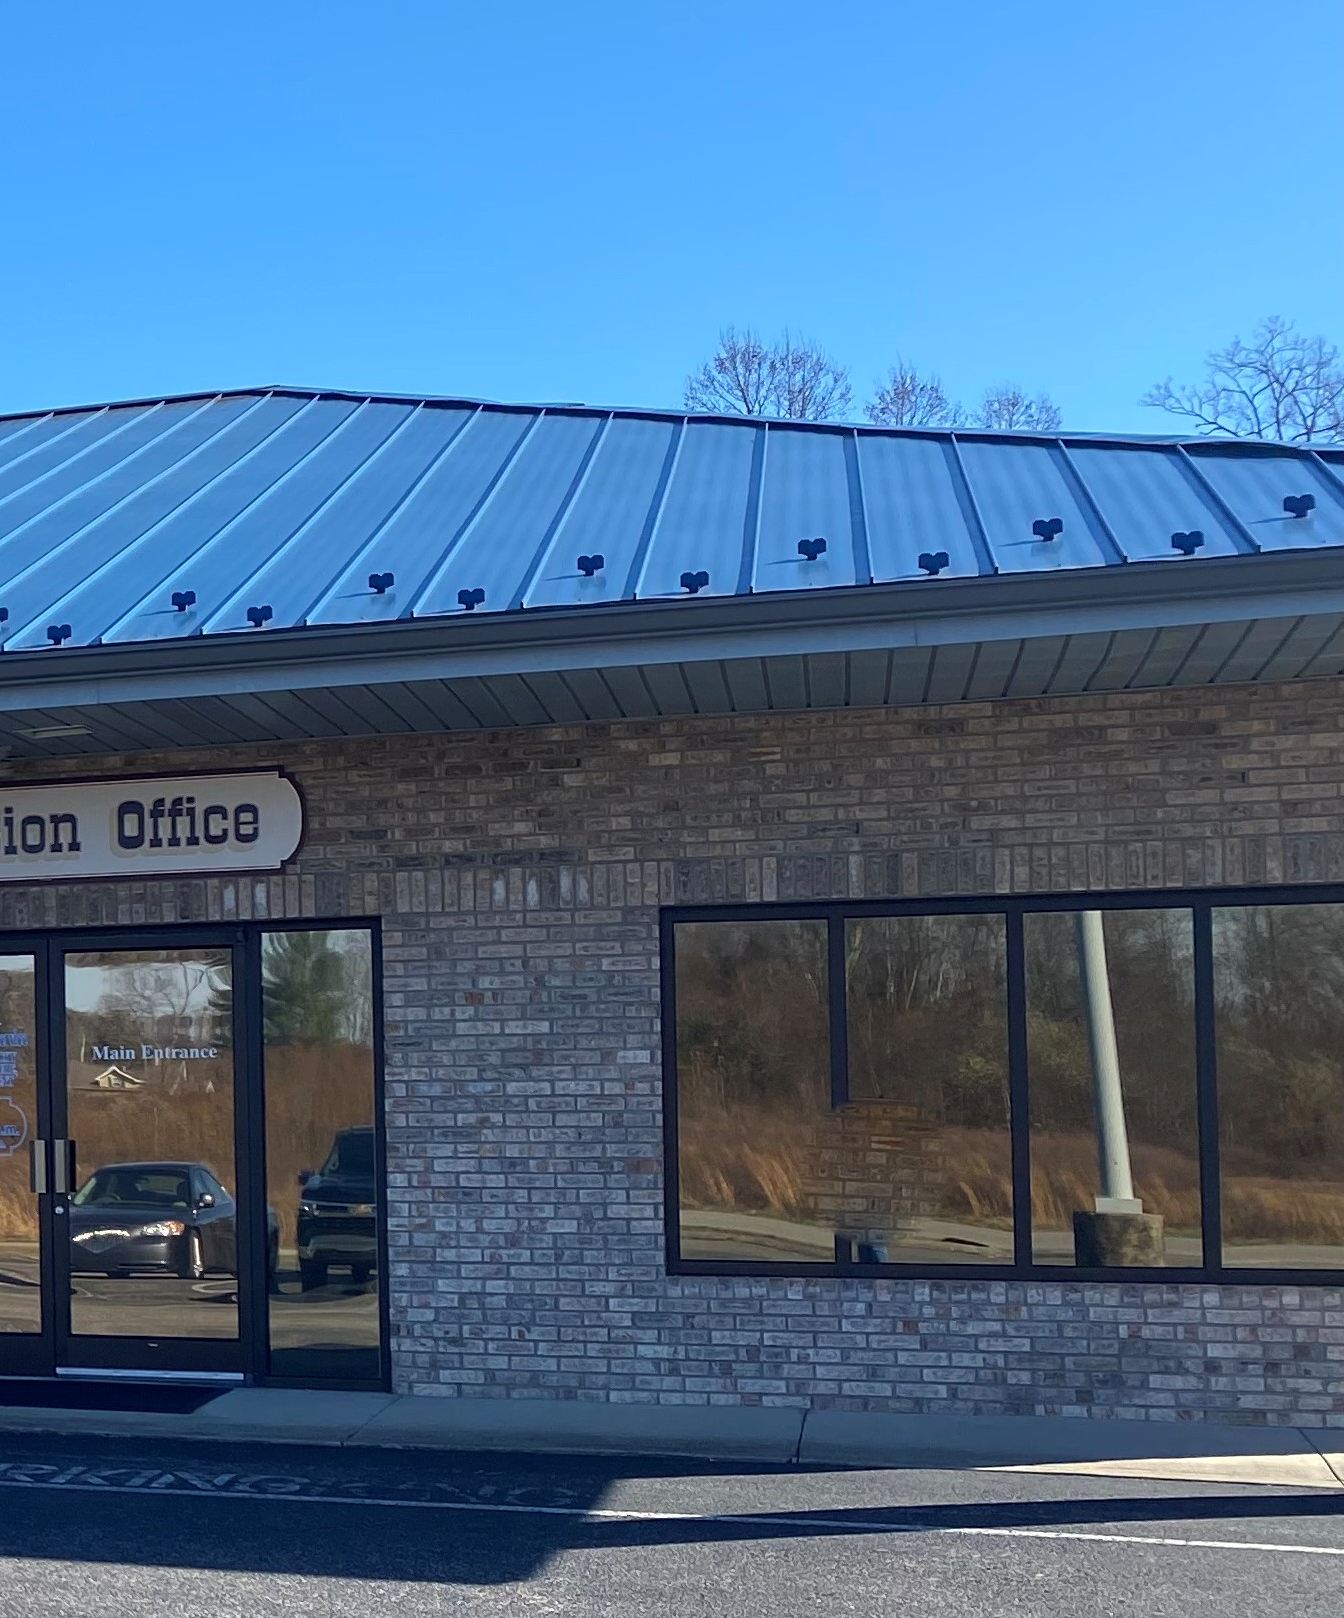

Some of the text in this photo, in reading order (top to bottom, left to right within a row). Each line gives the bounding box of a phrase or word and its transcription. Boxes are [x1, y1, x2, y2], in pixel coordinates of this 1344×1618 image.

[116, 796, 260, 850] Office
[91, 1044, 218, 1061] Main Entrance
